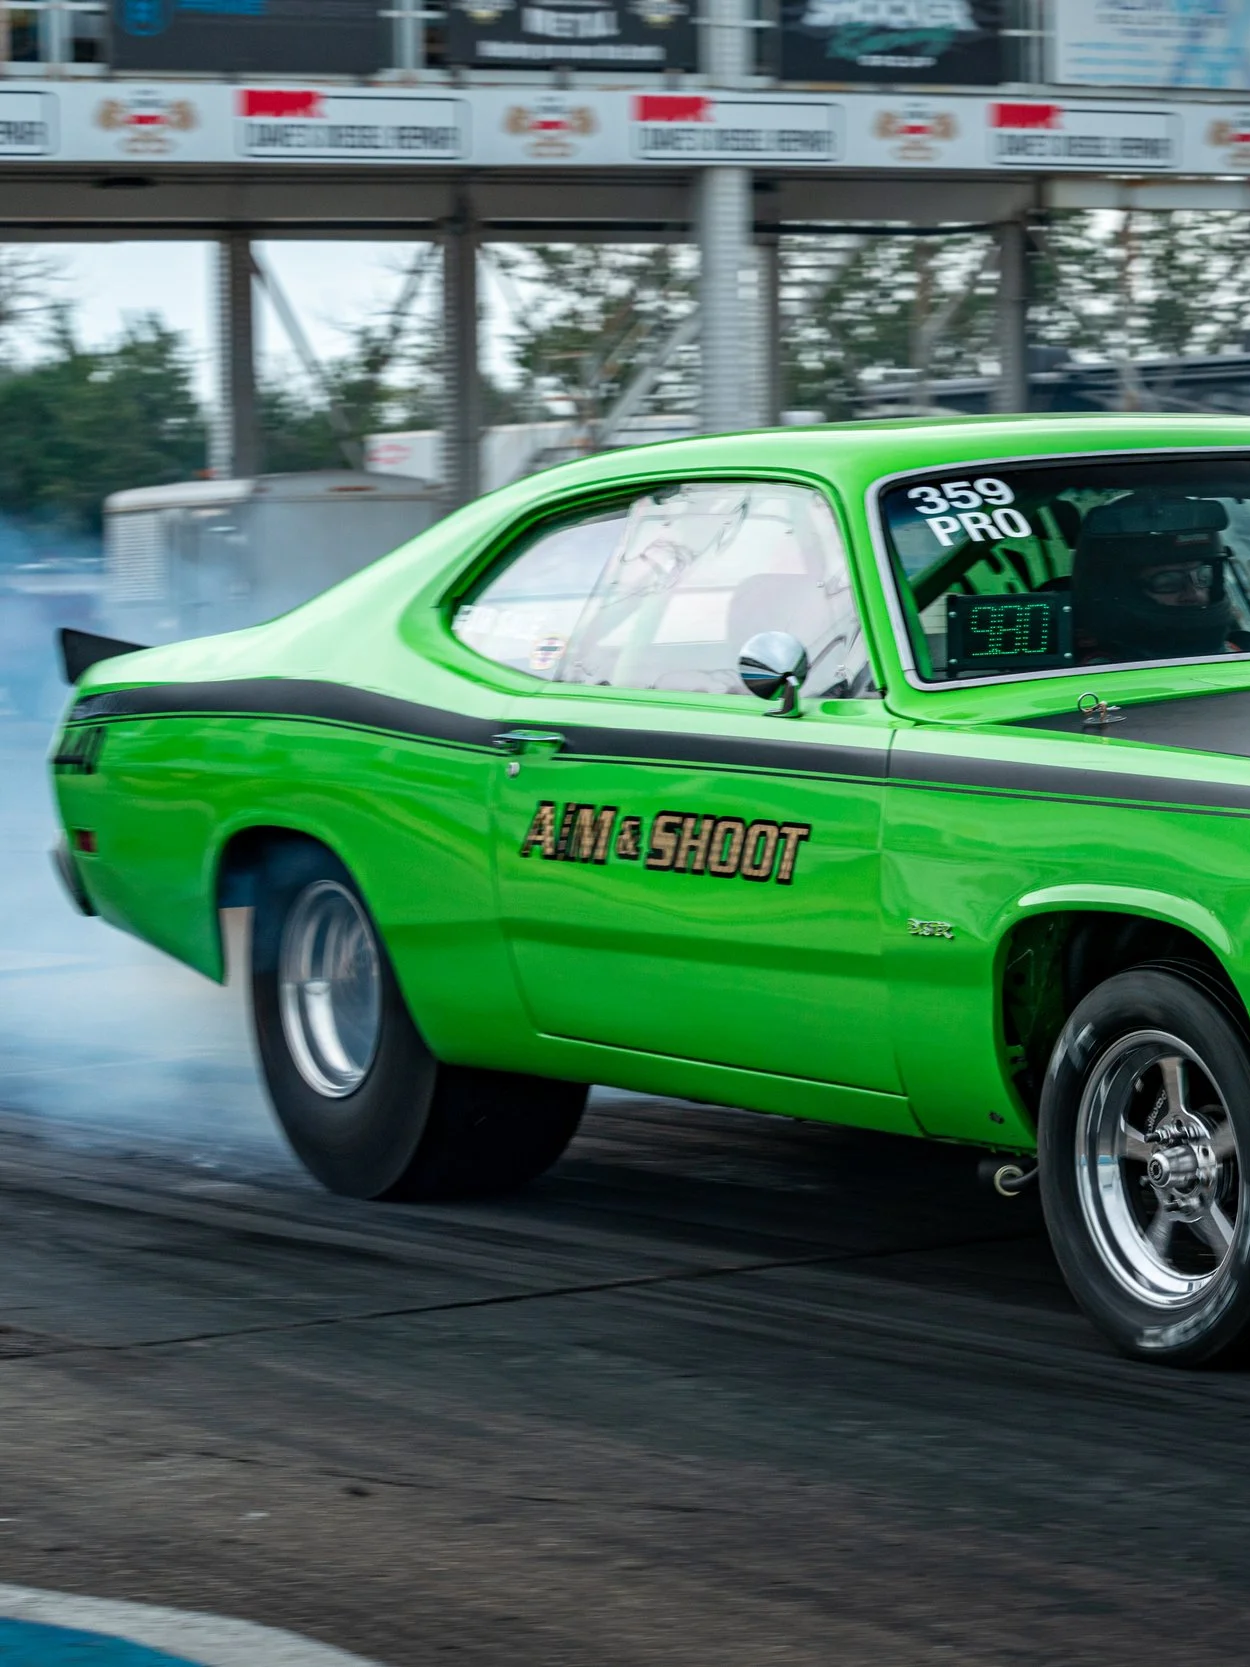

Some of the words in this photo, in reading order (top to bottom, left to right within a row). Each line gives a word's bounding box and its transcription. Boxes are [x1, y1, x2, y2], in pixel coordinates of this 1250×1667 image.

[907, 478, 1015, 515] 359
[924, 508, 1032, 546] PRO
[519, 800, 618, 865] AIM
[617, 816, 642, 860] &
[645, 810, 811, 885] SHOOT
